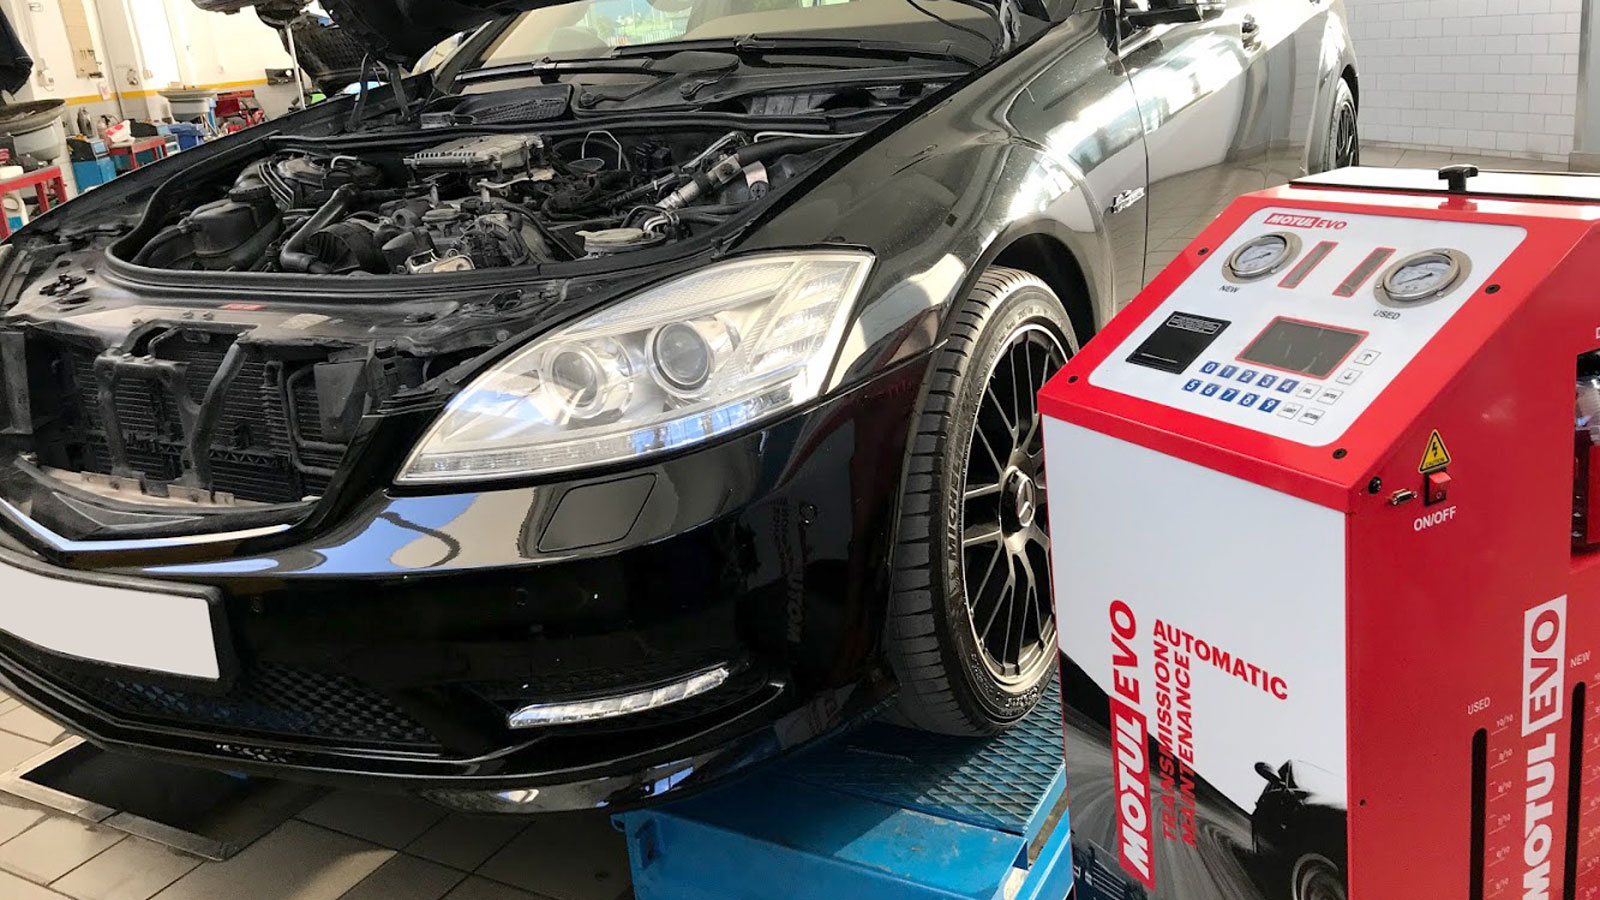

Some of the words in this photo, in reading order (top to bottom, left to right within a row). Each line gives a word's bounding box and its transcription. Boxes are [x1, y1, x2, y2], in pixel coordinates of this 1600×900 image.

[1267, 214, 1316, 227] MOTUL
[1316, 220, 1347, 230] EVO
[1219, 285, 1240, 293] NEW
[1373, 309, 1400, 320] USED
[1413, 505, 1457, 531] ON/OFF
[1109, 600, 1141, 705] EVO
[1153, 618, 1288, 701] AUTOMATIC
[1529, 608, 1560, 725] EVO
[1570, 650, 1591, 668] NEW
[1153, 640, 1177, 842] TRANSMISSION
[1467, 696, 1491, 715] USED
[1174, 651, 1197, 848] MAINTENANCE
[1115, 711, 1150, 880] MOTUL
[1522, 732, 1556, 900] MOTUL
